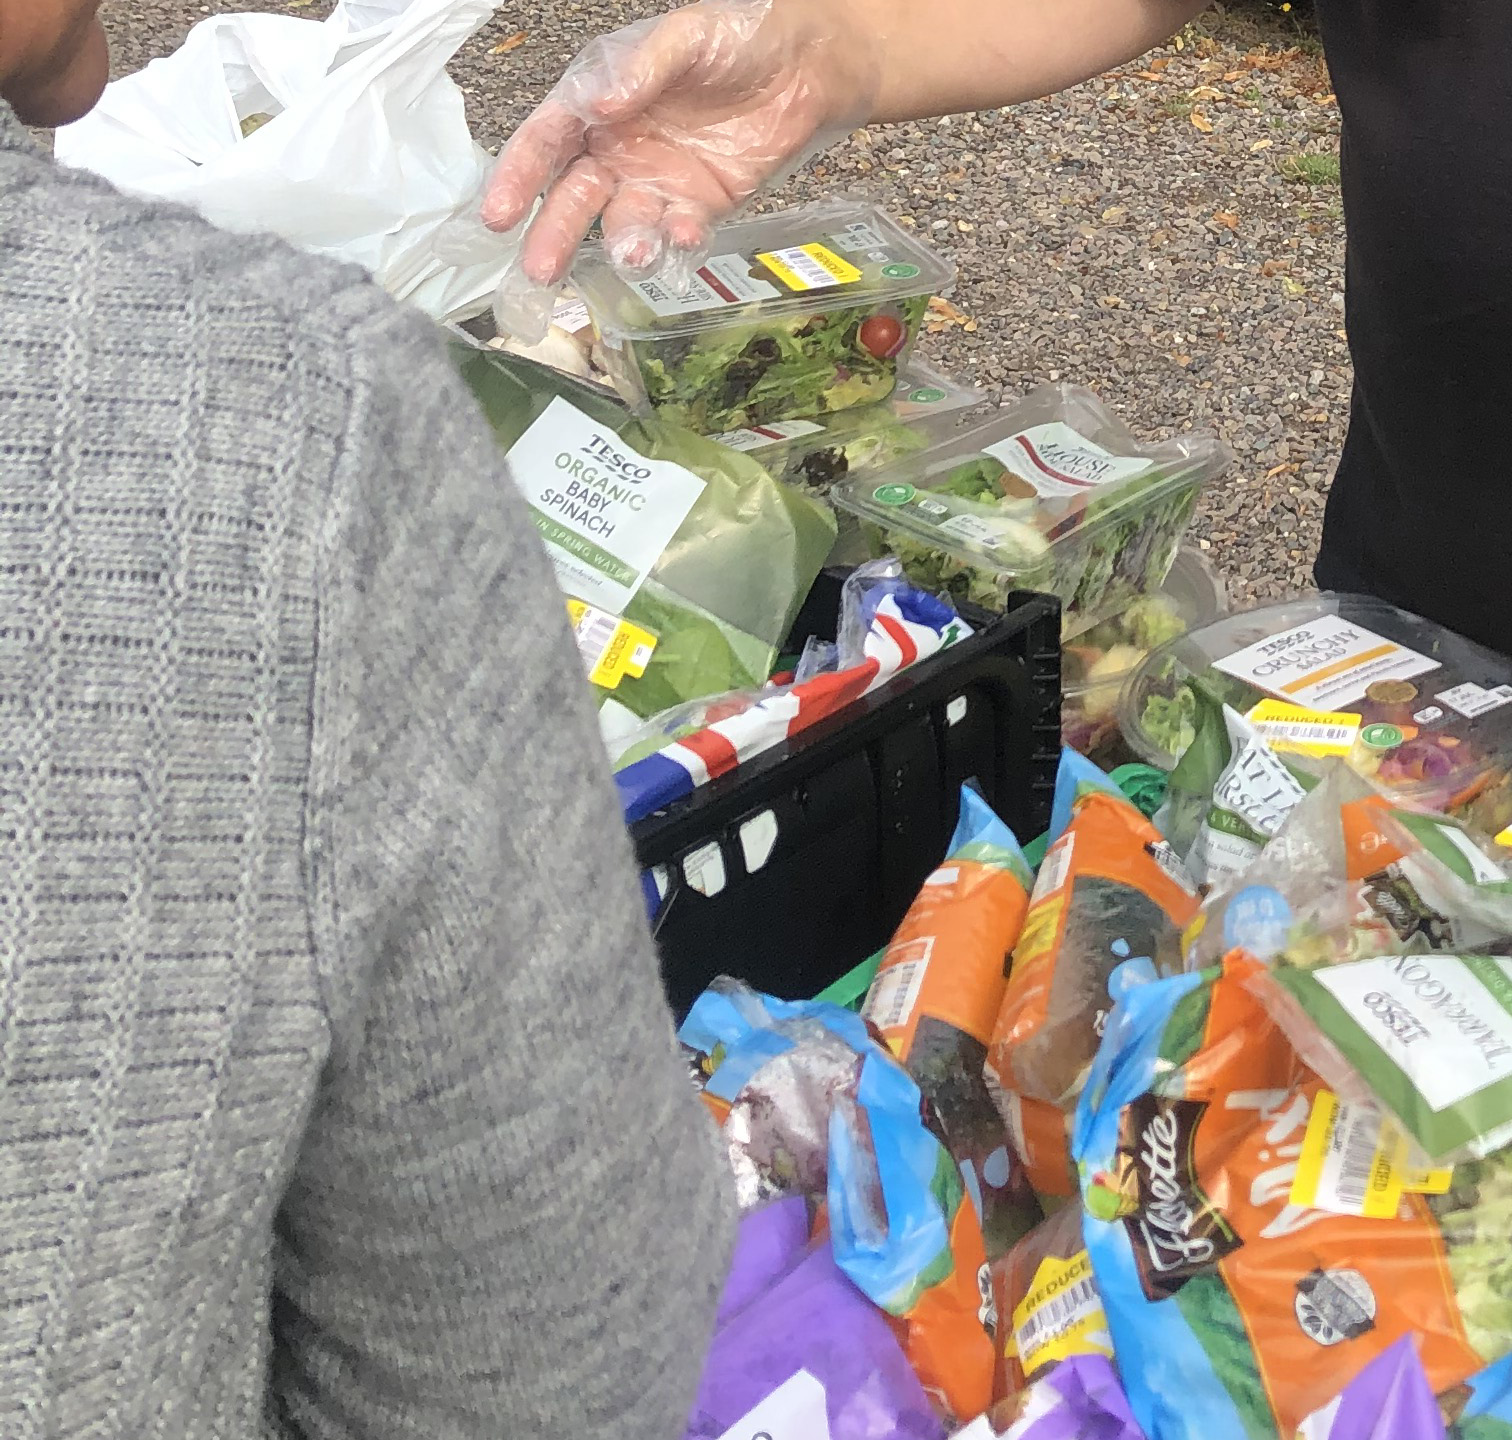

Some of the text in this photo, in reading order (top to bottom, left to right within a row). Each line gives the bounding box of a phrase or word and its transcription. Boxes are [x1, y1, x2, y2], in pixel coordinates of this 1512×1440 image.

[554, 452, 646, 511] ORGANIC
[585, 433, 652, 481] TESCO
[540, 488, 616, 539] SPINACH
[566, 481, 612, 513] BABY
[536, 518, 633, 582] IN SPRING WATER
[1252, 629, 1361, 677] CRUNCHY
[1256, 630, 1315, 657] TESCO
[1362, 991, 1432, 1047] TESCO
[1138, 1109, 1215, 1272] Florette
